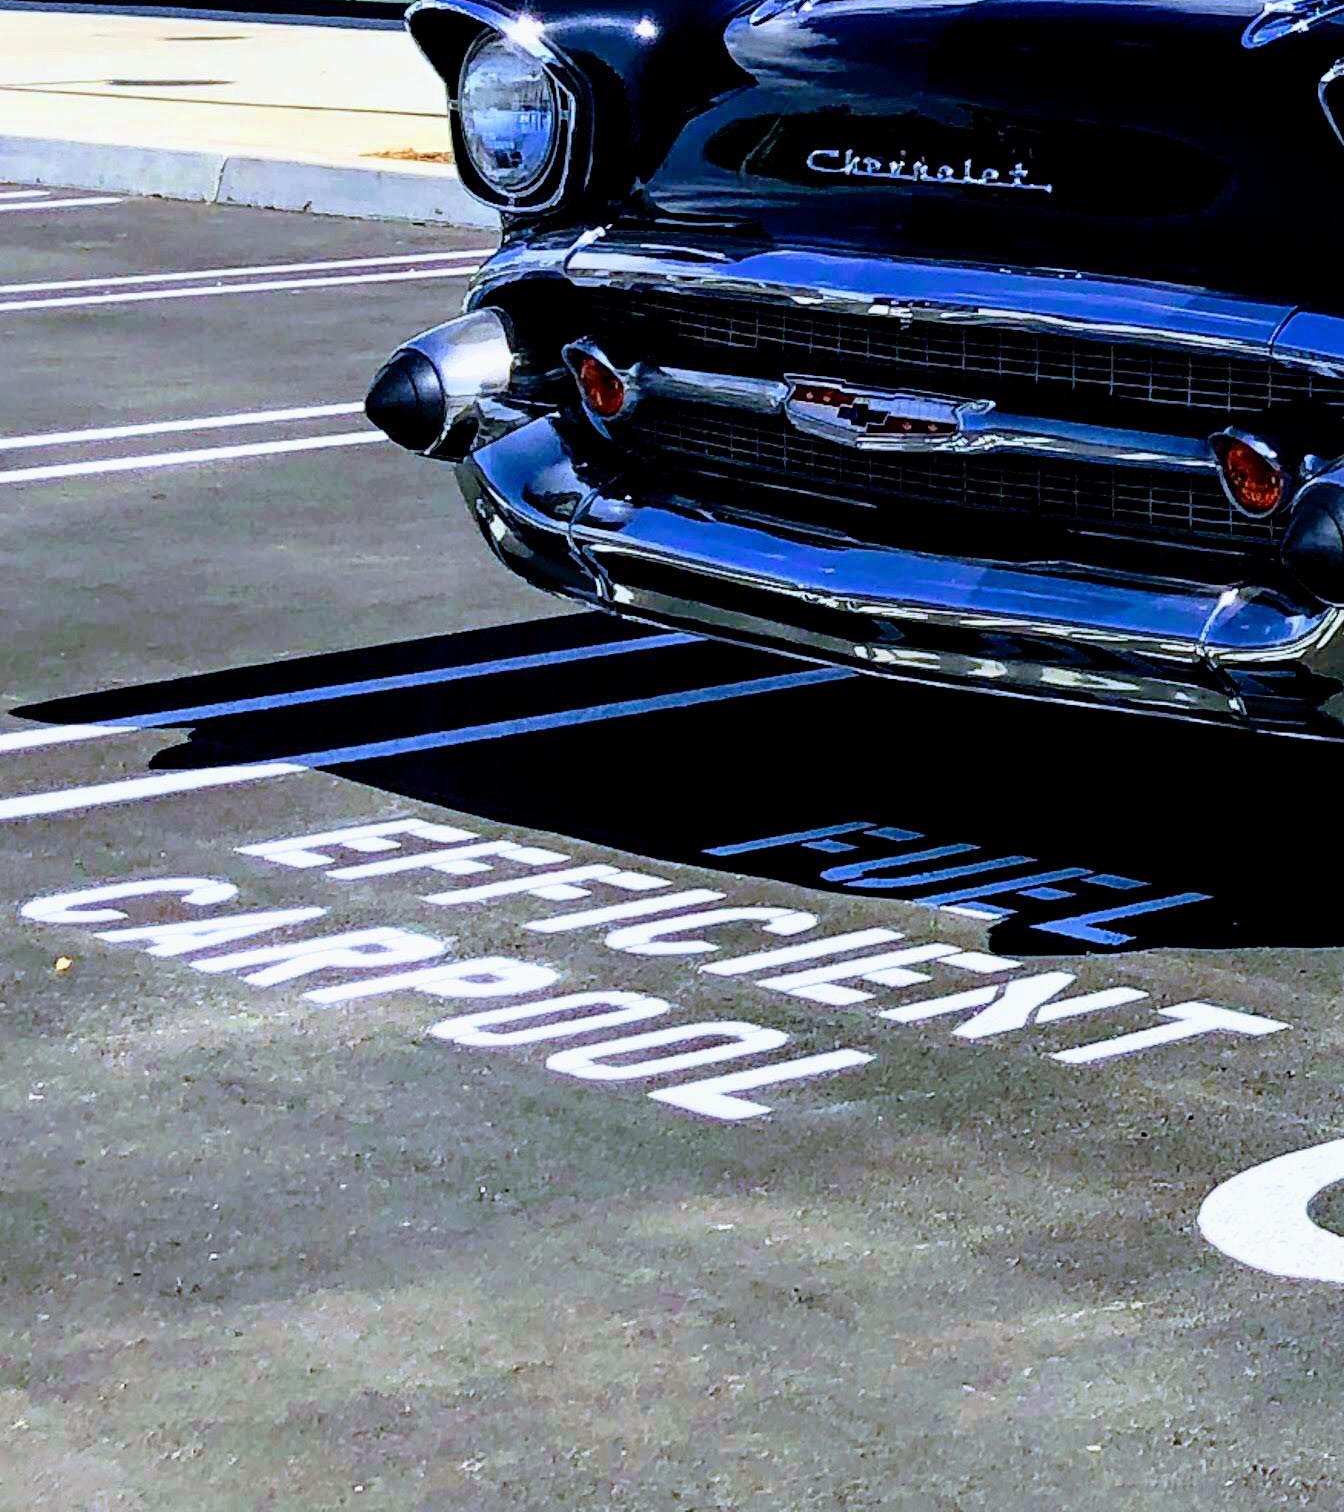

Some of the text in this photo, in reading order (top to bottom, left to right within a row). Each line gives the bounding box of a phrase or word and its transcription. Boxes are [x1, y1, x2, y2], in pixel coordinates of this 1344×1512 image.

[806, 149, 1052, 192] Chevrolet
[232, 818, 1294, 1065] EFFICIENT
[702, 821, 1213, 946] FUEL
[20, 877, 877, 1120] CARPOOL
